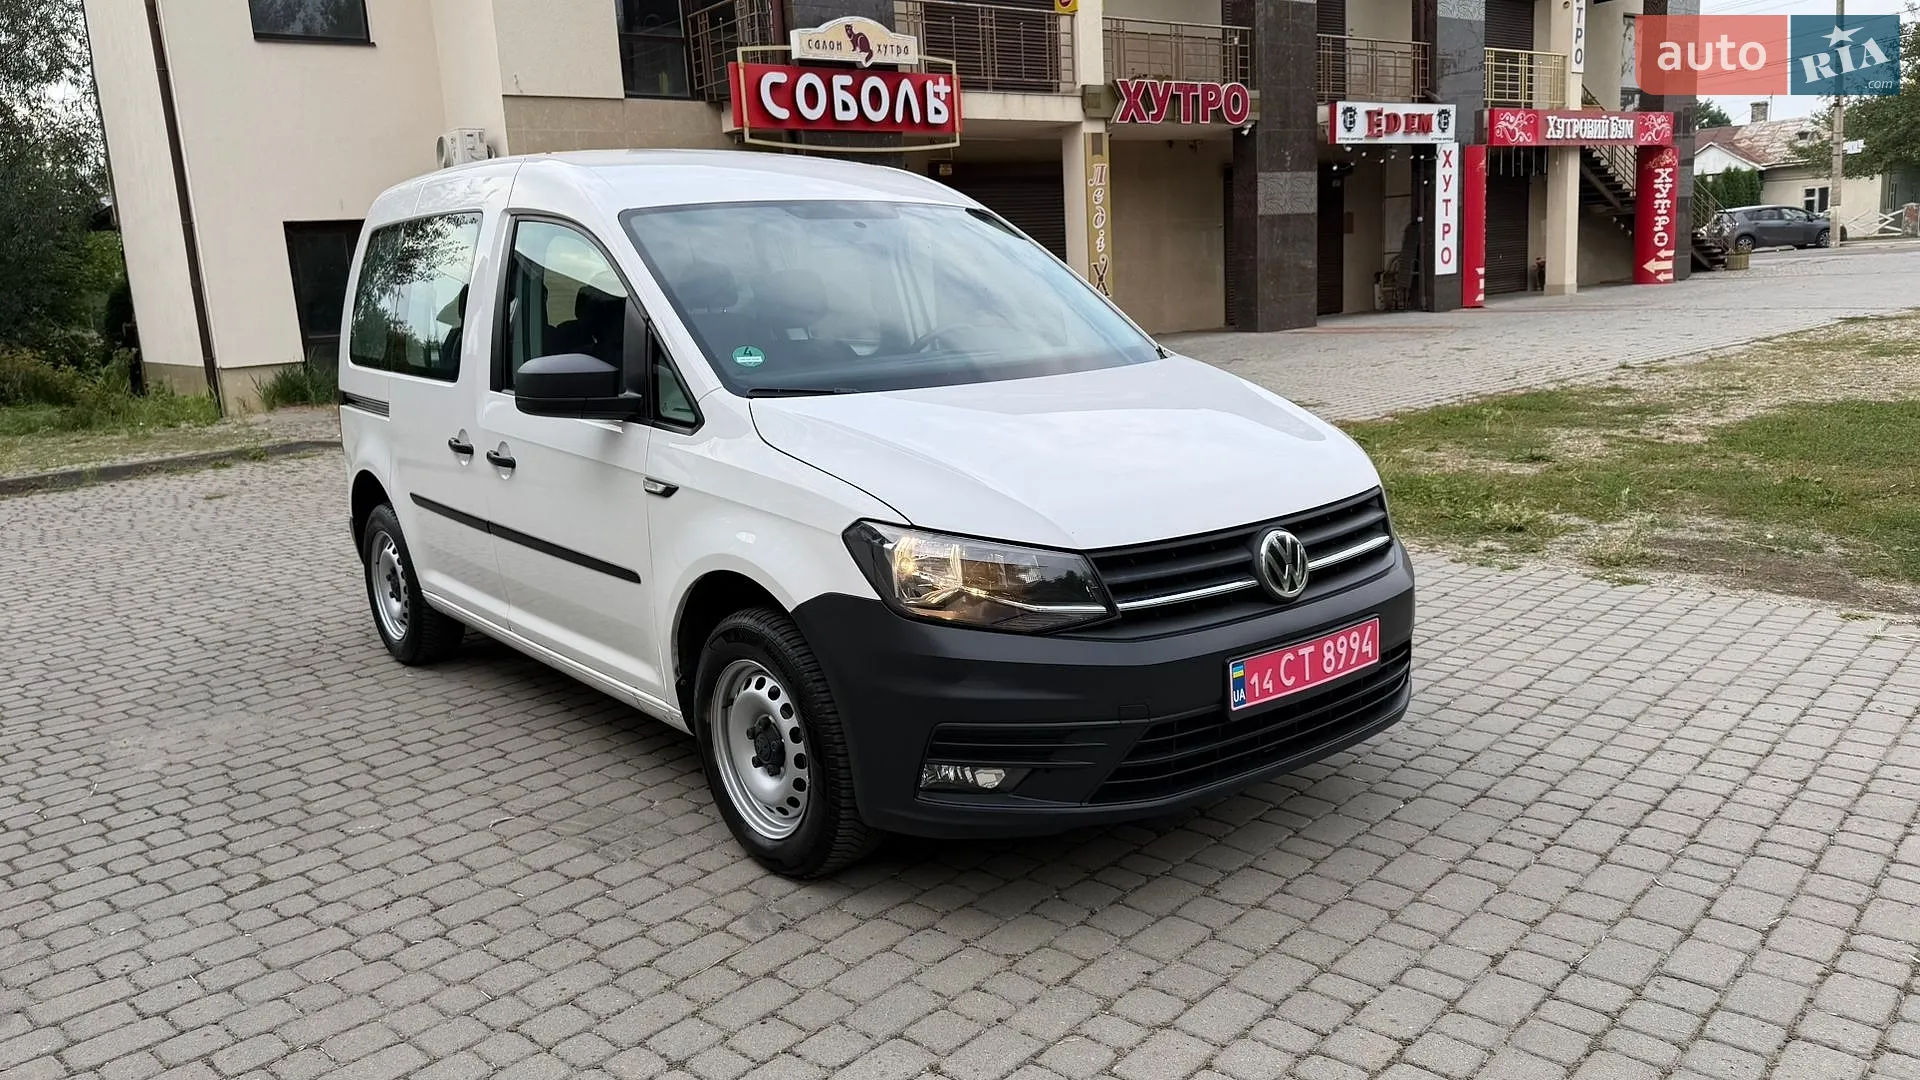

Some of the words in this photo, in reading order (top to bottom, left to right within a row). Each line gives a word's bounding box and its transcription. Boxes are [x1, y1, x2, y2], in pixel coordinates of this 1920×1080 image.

[1574, 0, 1584, 64] ТРО
[1115, 79, 1250, 125] ХУТРО
[1440, 150, 1453, 265] ХУТРО
[1653, 167, 1674, 247] ХУТРО
[1250, 668, 1273, 697] 14
[1322, 625, 1372, 673] 8994
[1233, 690, 1246, 703] UA
